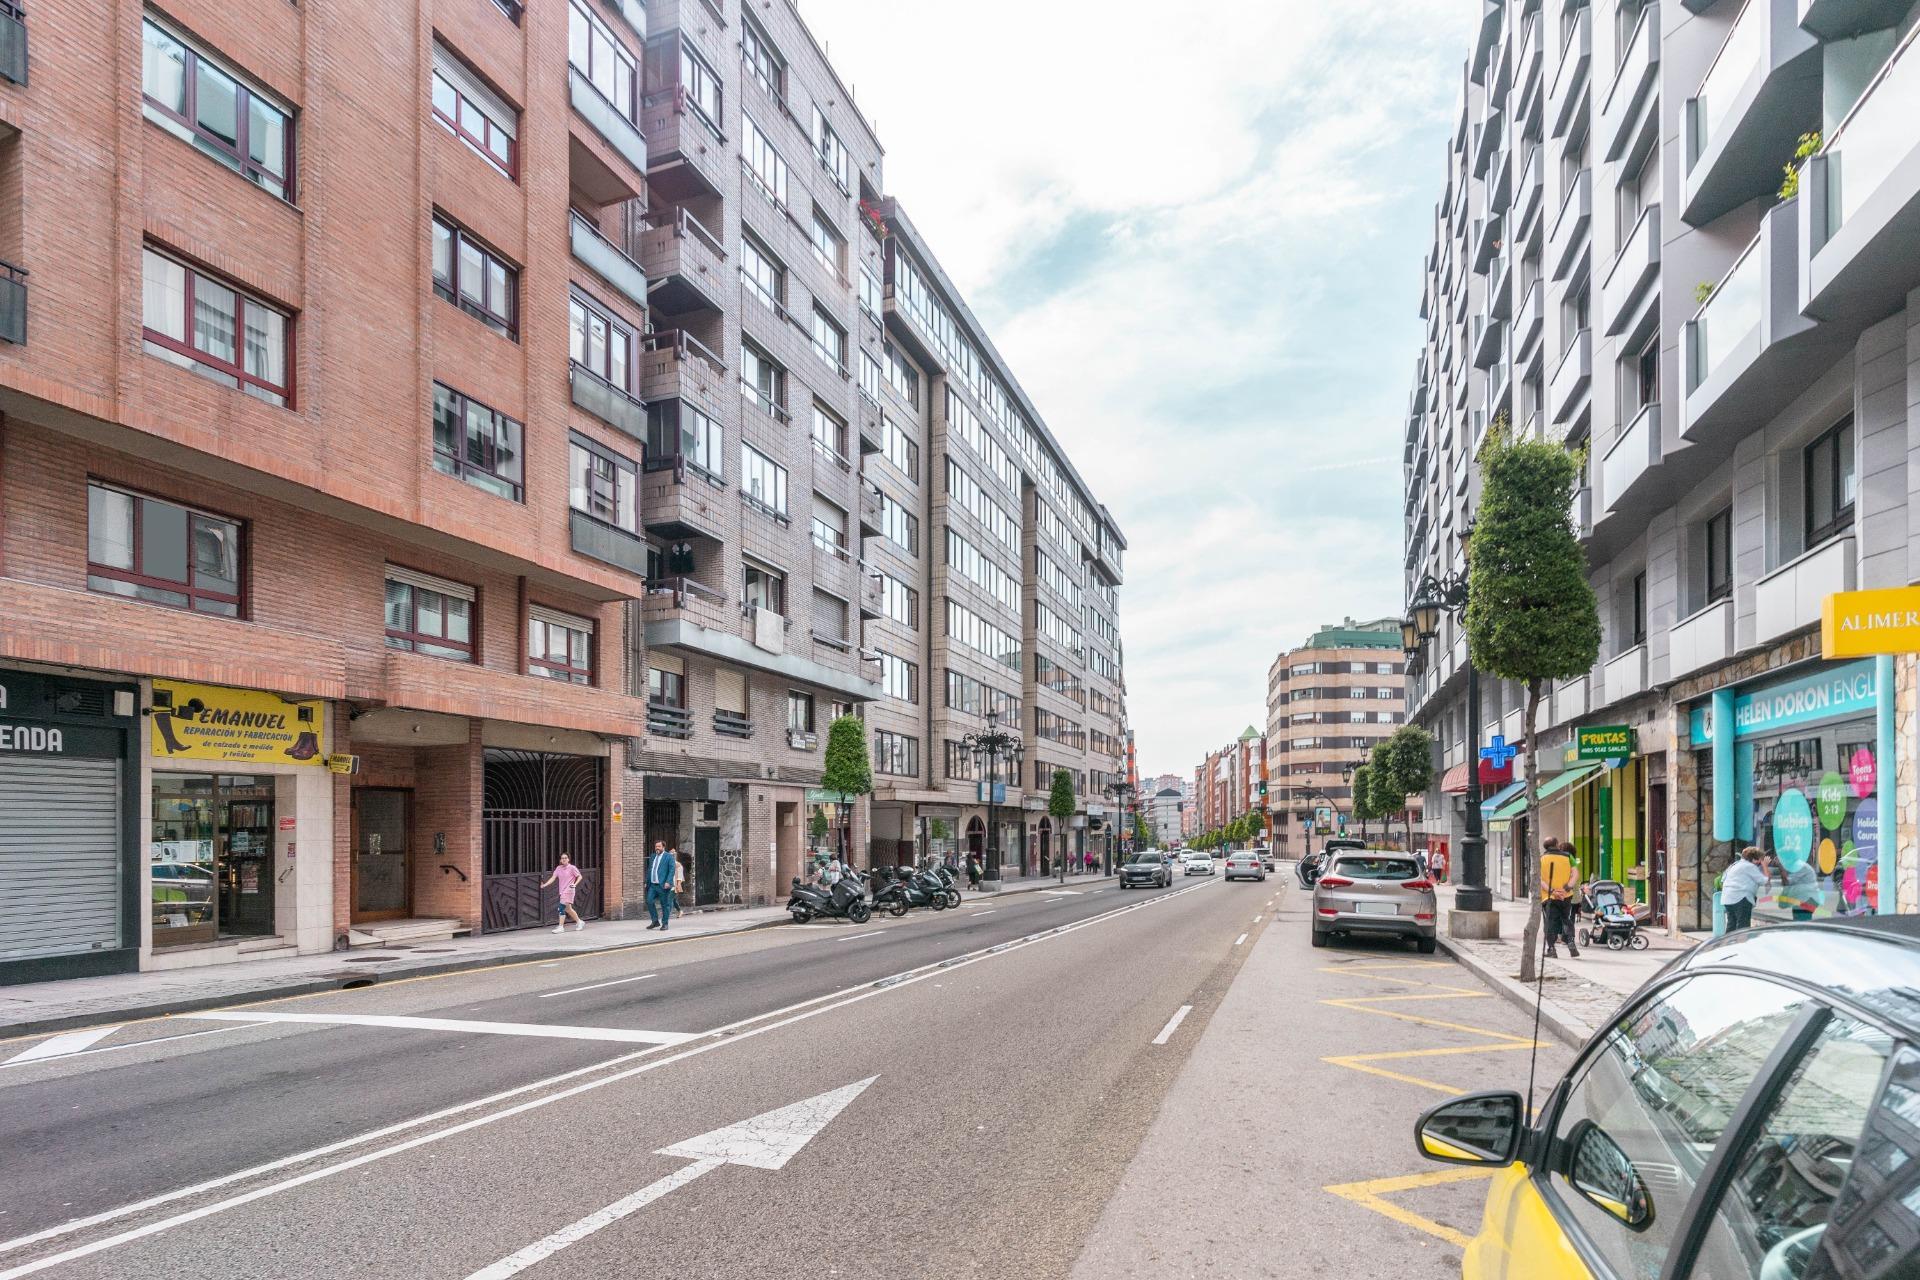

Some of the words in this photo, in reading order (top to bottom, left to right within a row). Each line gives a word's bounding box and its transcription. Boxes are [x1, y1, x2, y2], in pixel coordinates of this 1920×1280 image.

[1736, 701, 1771, 727] HELEN
[1775, 684, 1829, 718] DORON
[199, 708, 286, 729] EMANUEL
[183, 726, 235, 738] REPARACIÓN
[1581, 732, 1627, 746] FRUTAS
[1852, 765, 1872, 775] Teens
[1822, 788, 1841, 802] Kids
[1824, 805, 1839, 815] 2-12
[1778, 814, 1809, 829] Babies
